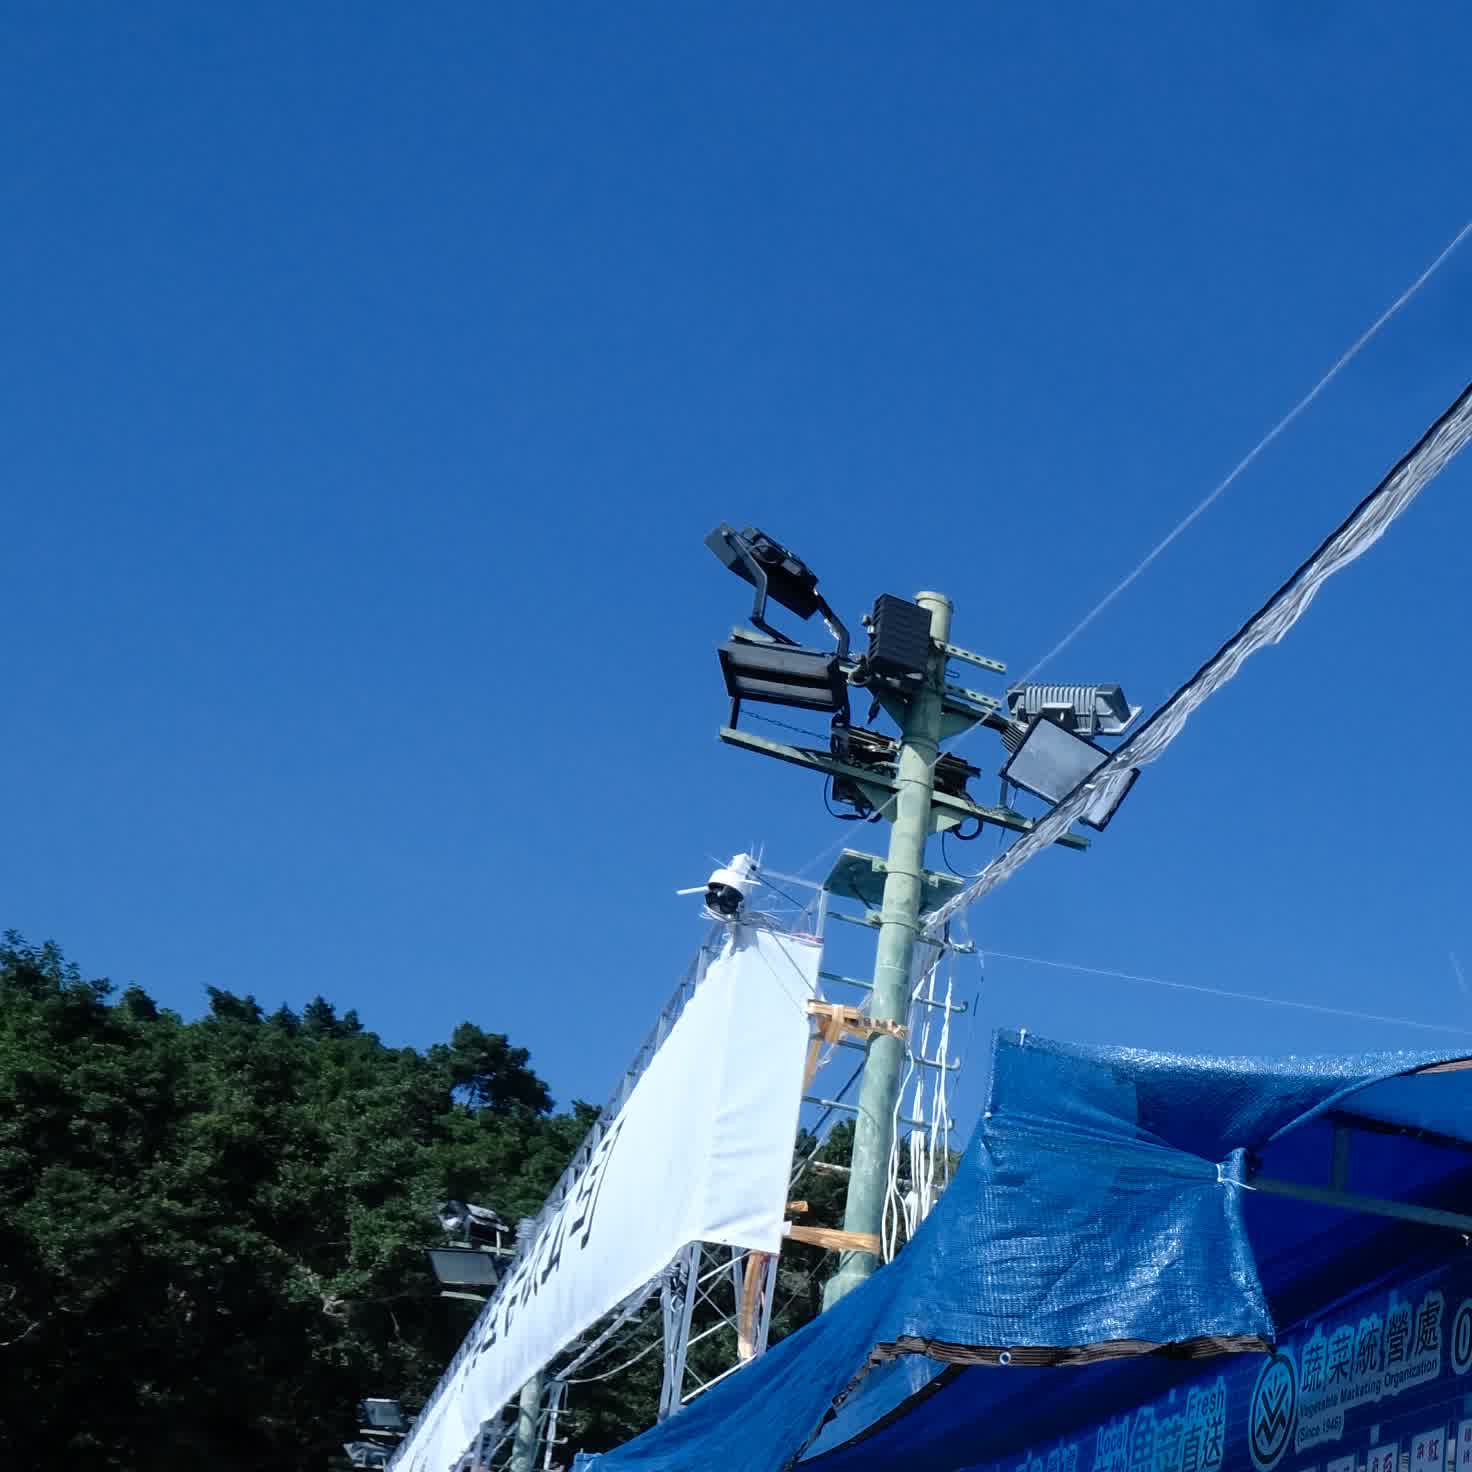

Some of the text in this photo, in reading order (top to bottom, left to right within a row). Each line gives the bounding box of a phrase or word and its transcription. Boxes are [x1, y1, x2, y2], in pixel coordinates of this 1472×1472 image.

[1300, 1300, 1441, 1392] 蔬菜統營處
[1340, 1380, 1381, 1405] Marketing
[1383, 1359, 1438, 1386] Organization
